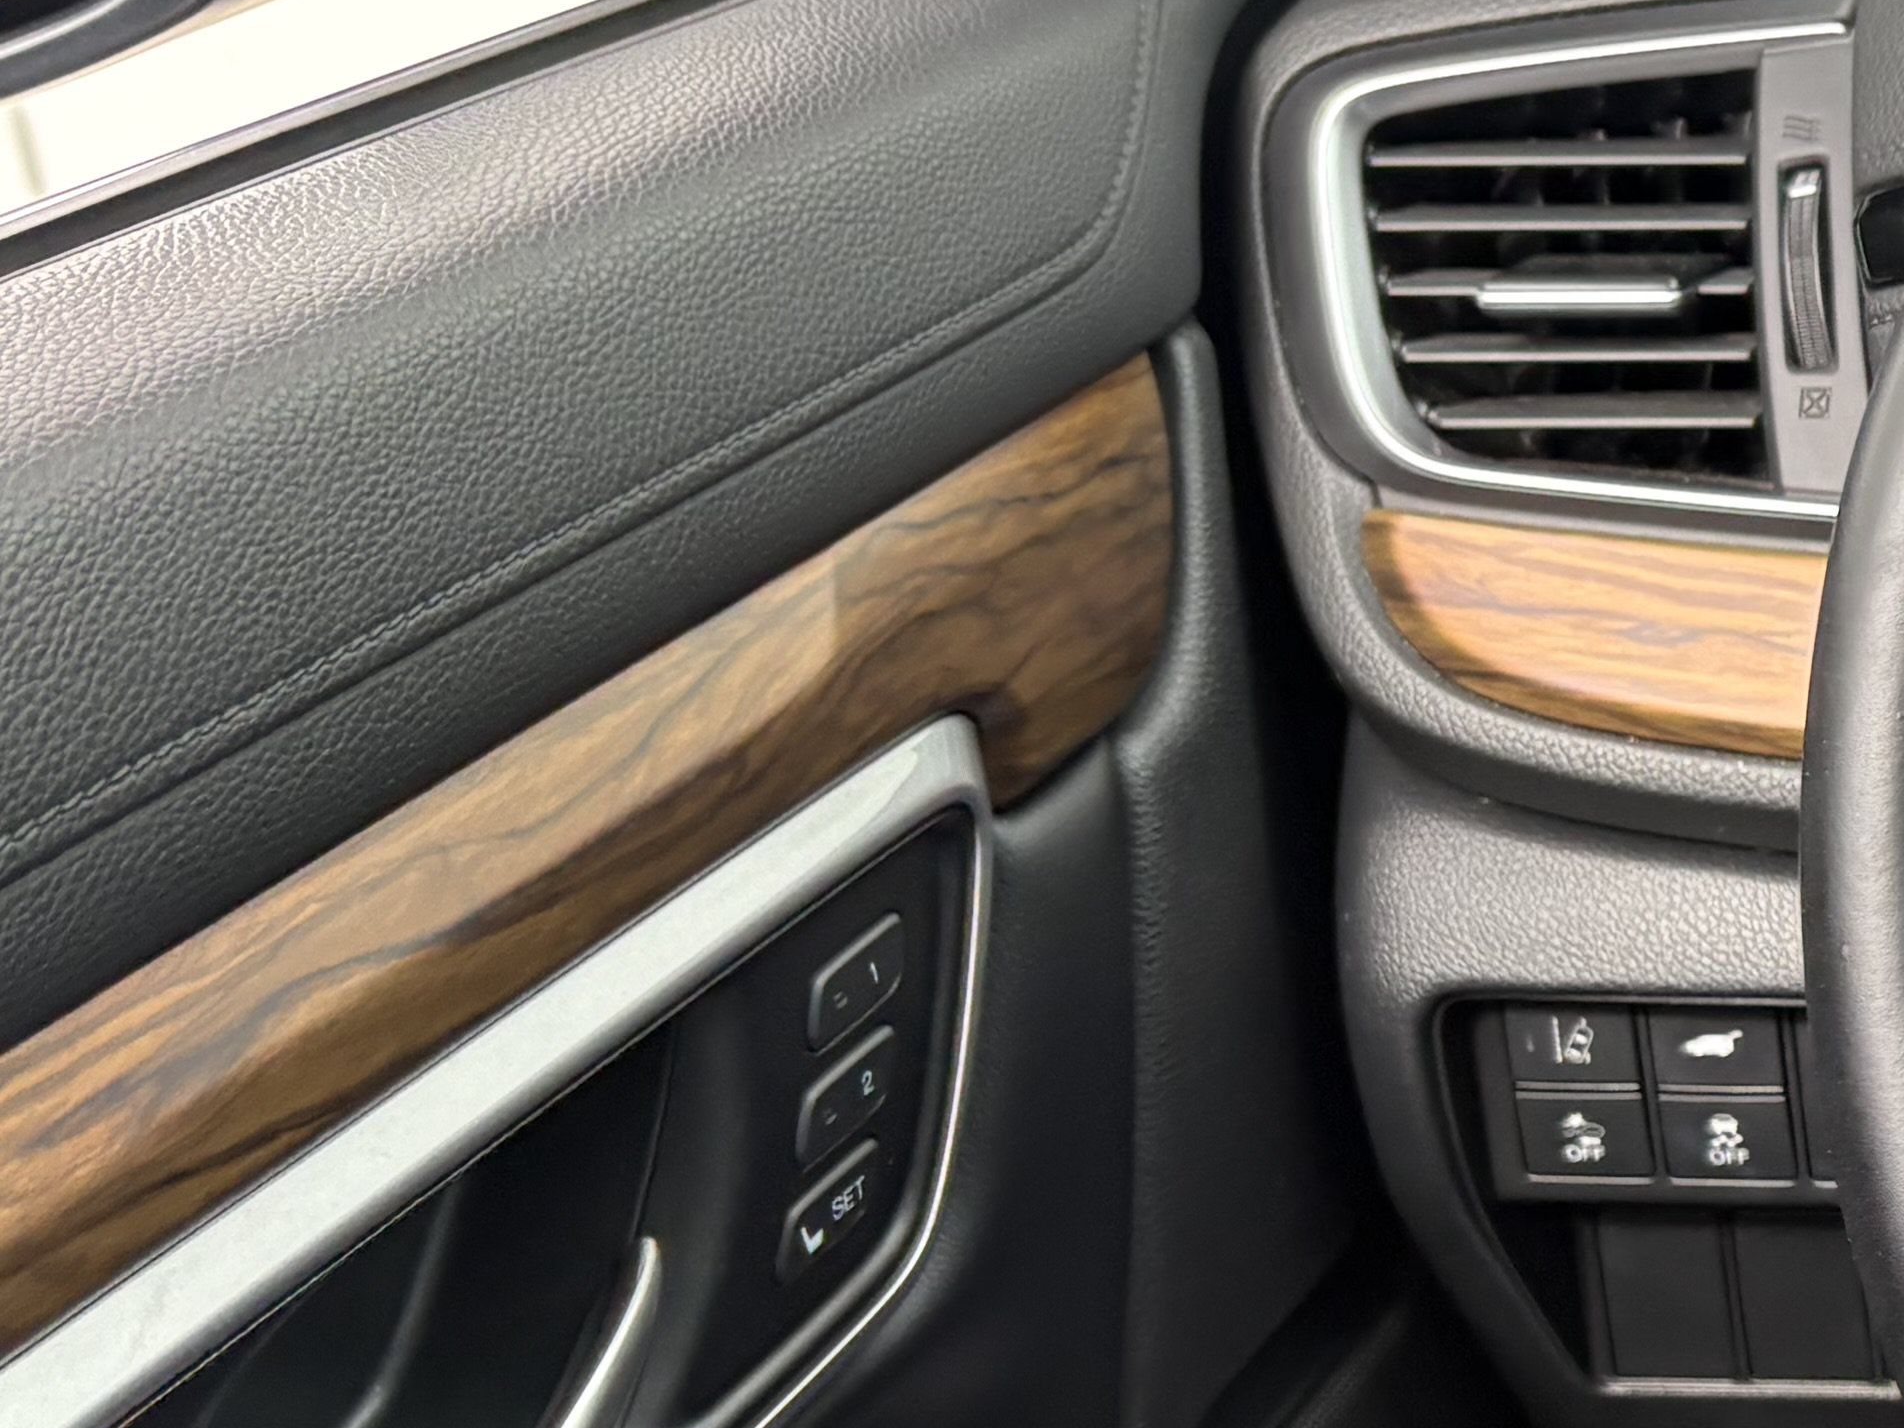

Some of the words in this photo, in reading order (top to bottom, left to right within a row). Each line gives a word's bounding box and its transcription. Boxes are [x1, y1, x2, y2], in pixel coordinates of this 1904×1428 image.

[870, 961, 879, 984] 1
[861, 1070, 876, 1096] 2
[832, 1174, 866, 1221] SET
